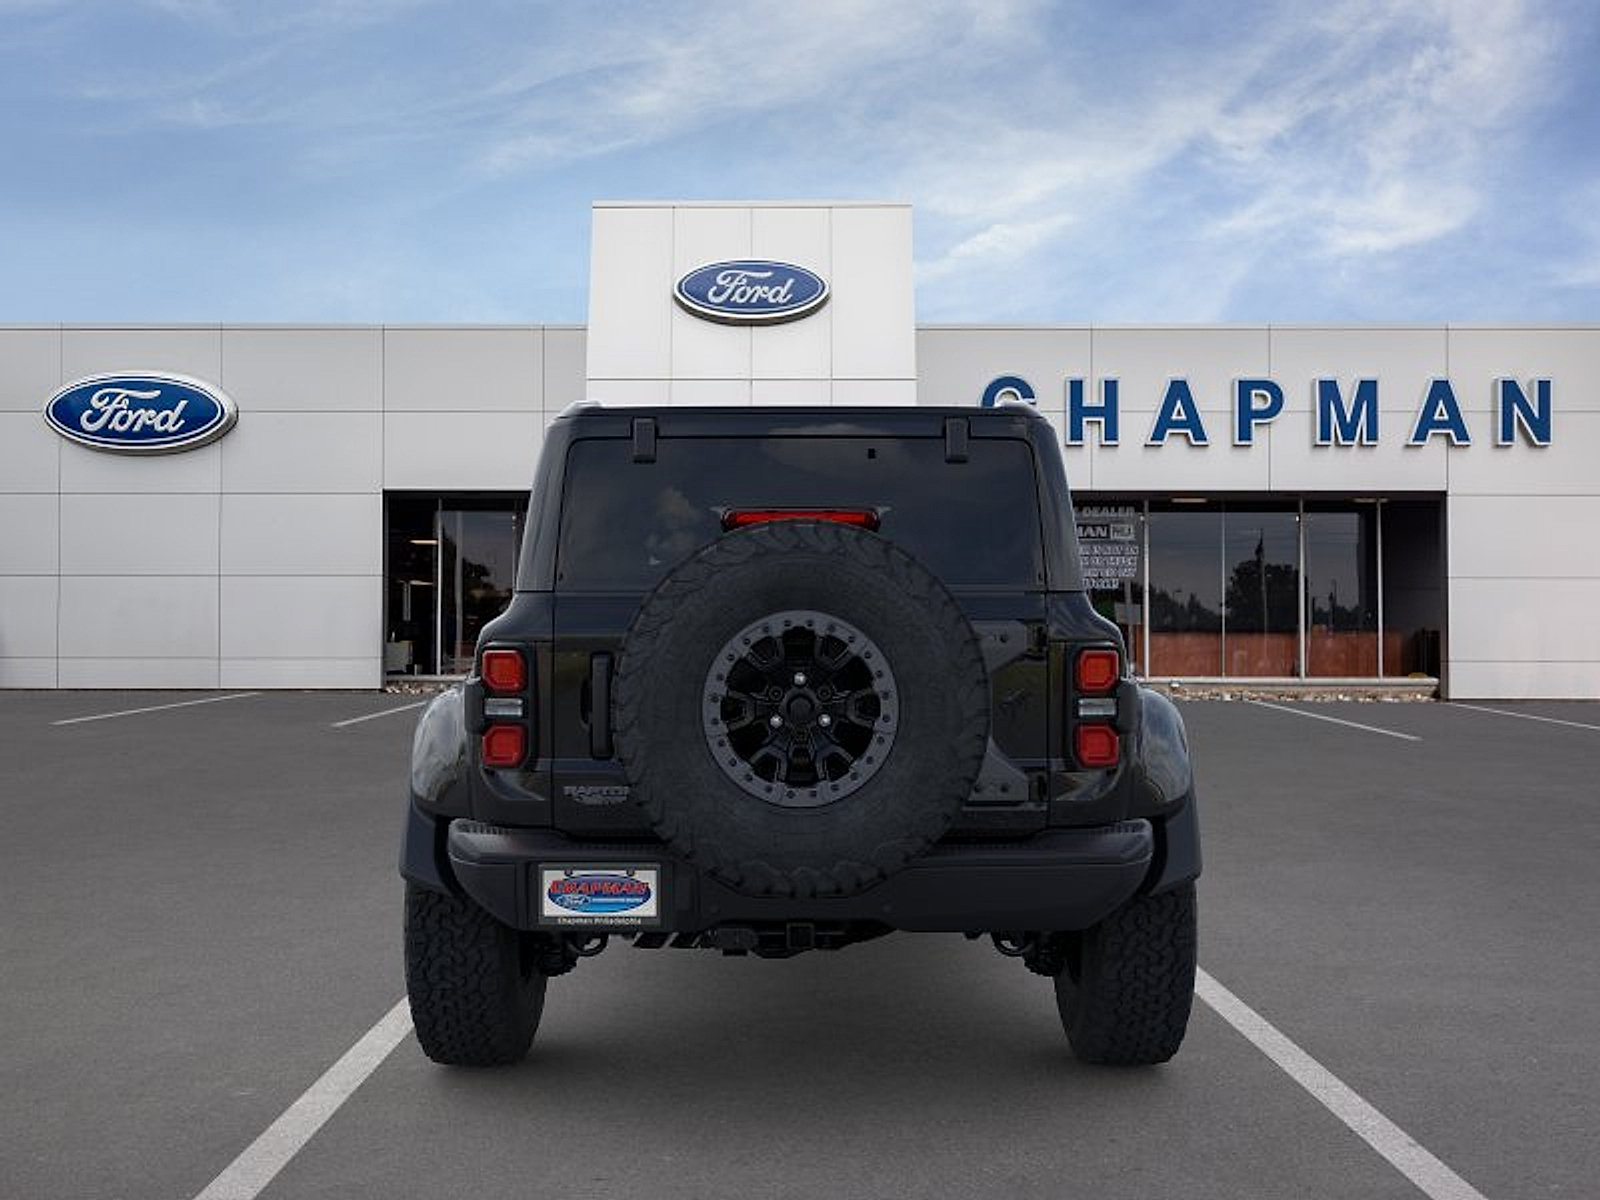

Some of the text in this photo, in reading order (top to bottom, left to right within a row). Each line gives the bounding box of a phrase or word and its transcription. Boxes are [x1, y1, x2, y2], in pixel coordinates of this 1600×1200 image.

[708, 269, 795, 304] Ford
[80, 387, 189, 432] Ford
[550, 880, 649, 895] CHAPMAN
